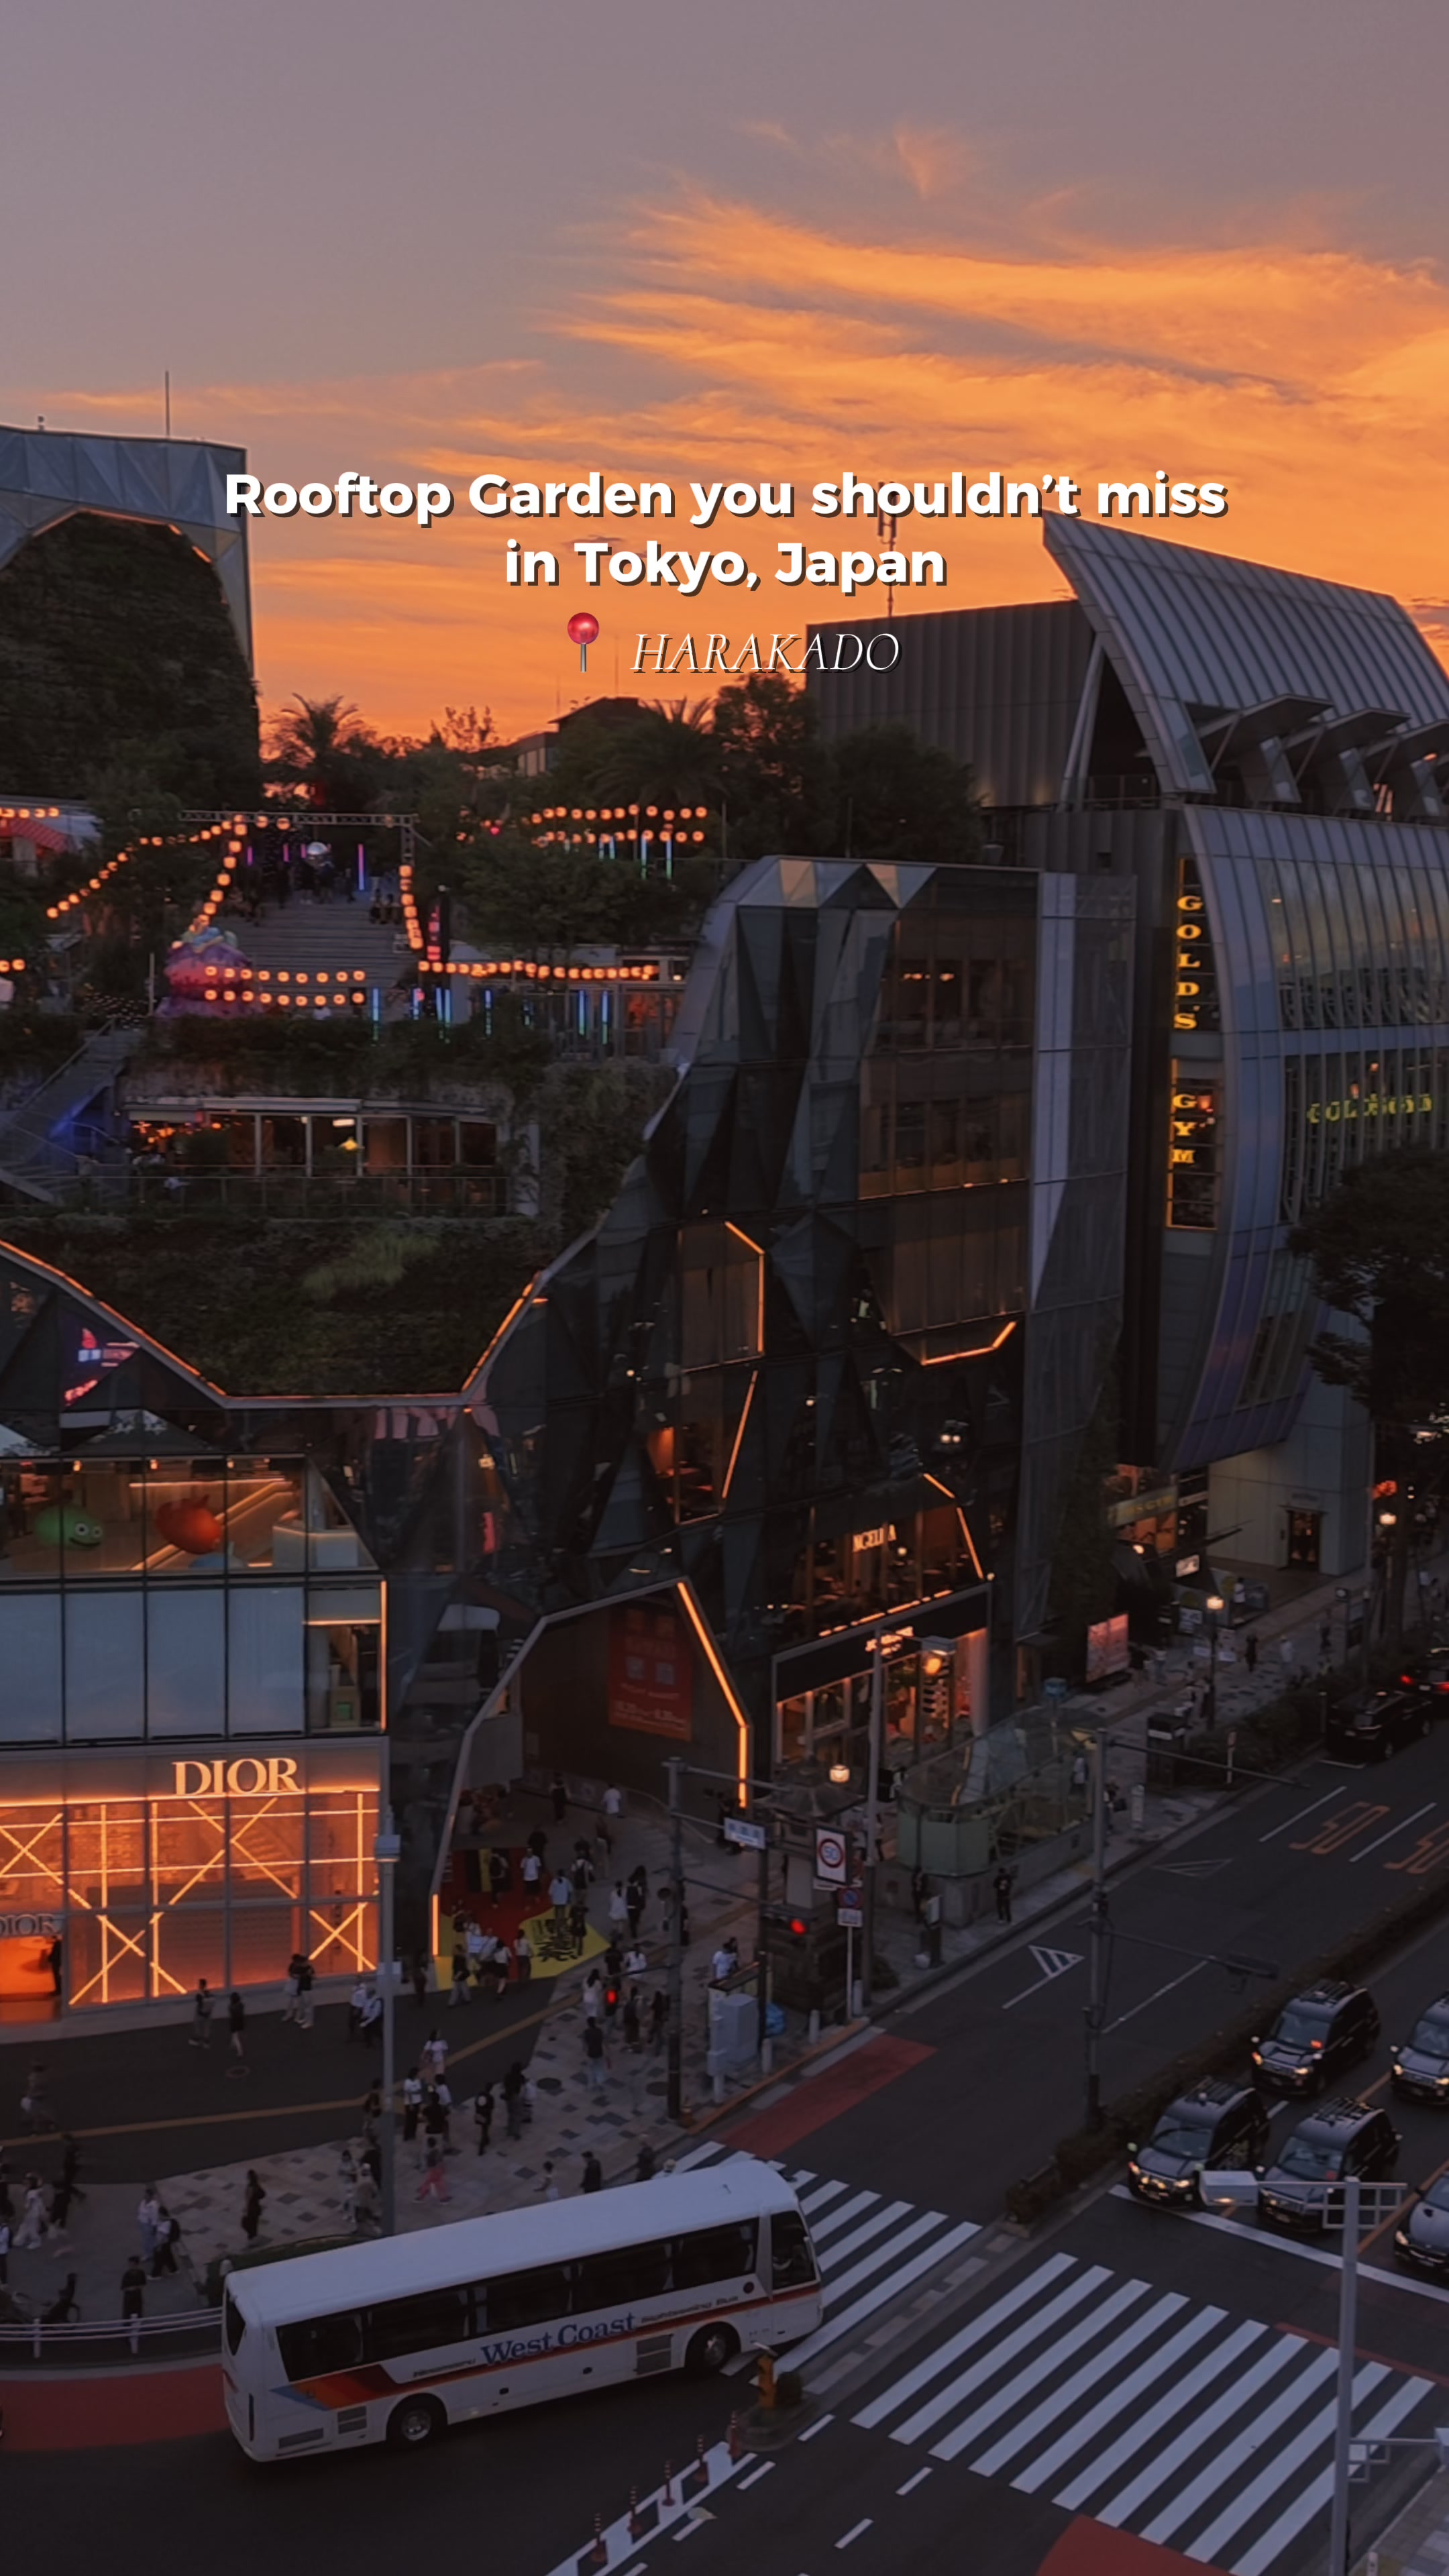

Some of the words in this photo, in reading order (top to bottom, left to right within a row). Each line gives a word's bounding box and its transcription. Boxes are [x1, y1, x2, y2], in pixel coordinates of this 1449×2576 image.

[1172, 1094, 1197, 1163] GYM
[172, 1758, 303, 1795] DIOR
[0, 1913, 57, 1935] IOR
[481, 2332, 553, 2365] West
[557, 2312, 637, 2346] Coast
